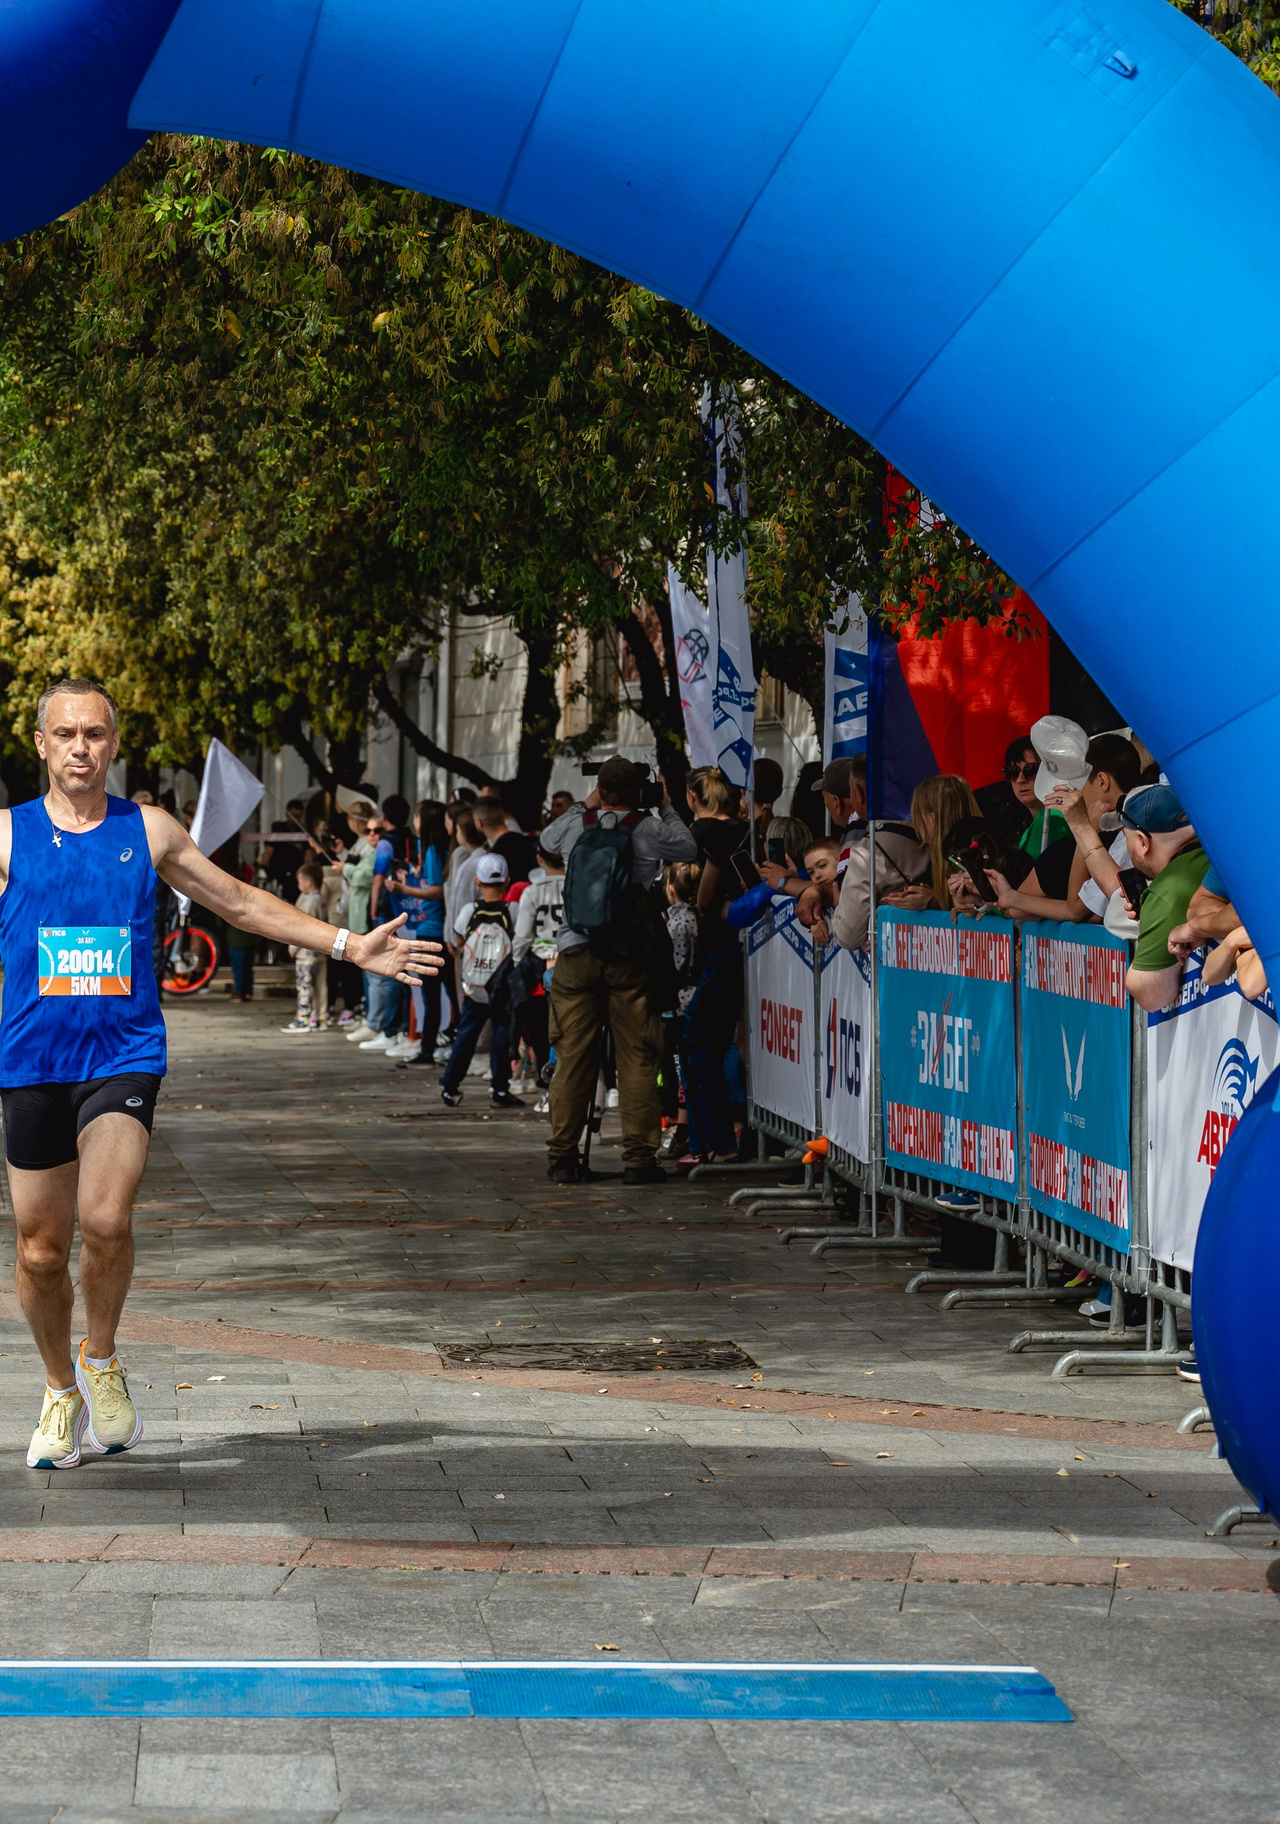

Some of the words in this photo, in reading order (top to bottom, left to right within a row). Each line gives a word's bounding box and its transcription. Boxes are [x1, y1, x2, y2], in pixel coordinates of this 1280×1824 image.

[57, 949, 114, 974] 20014
[912, 924, 958, 976] #СВОБОДА
[958, 930, 1012, 984] #ЕДИНСТВО
[761, 998, 803, 1065] FONBET
[840, 1017, 861, 1098] ПСБ
[980, 1124, 1015, 1184] #ЦЕЛЬ
